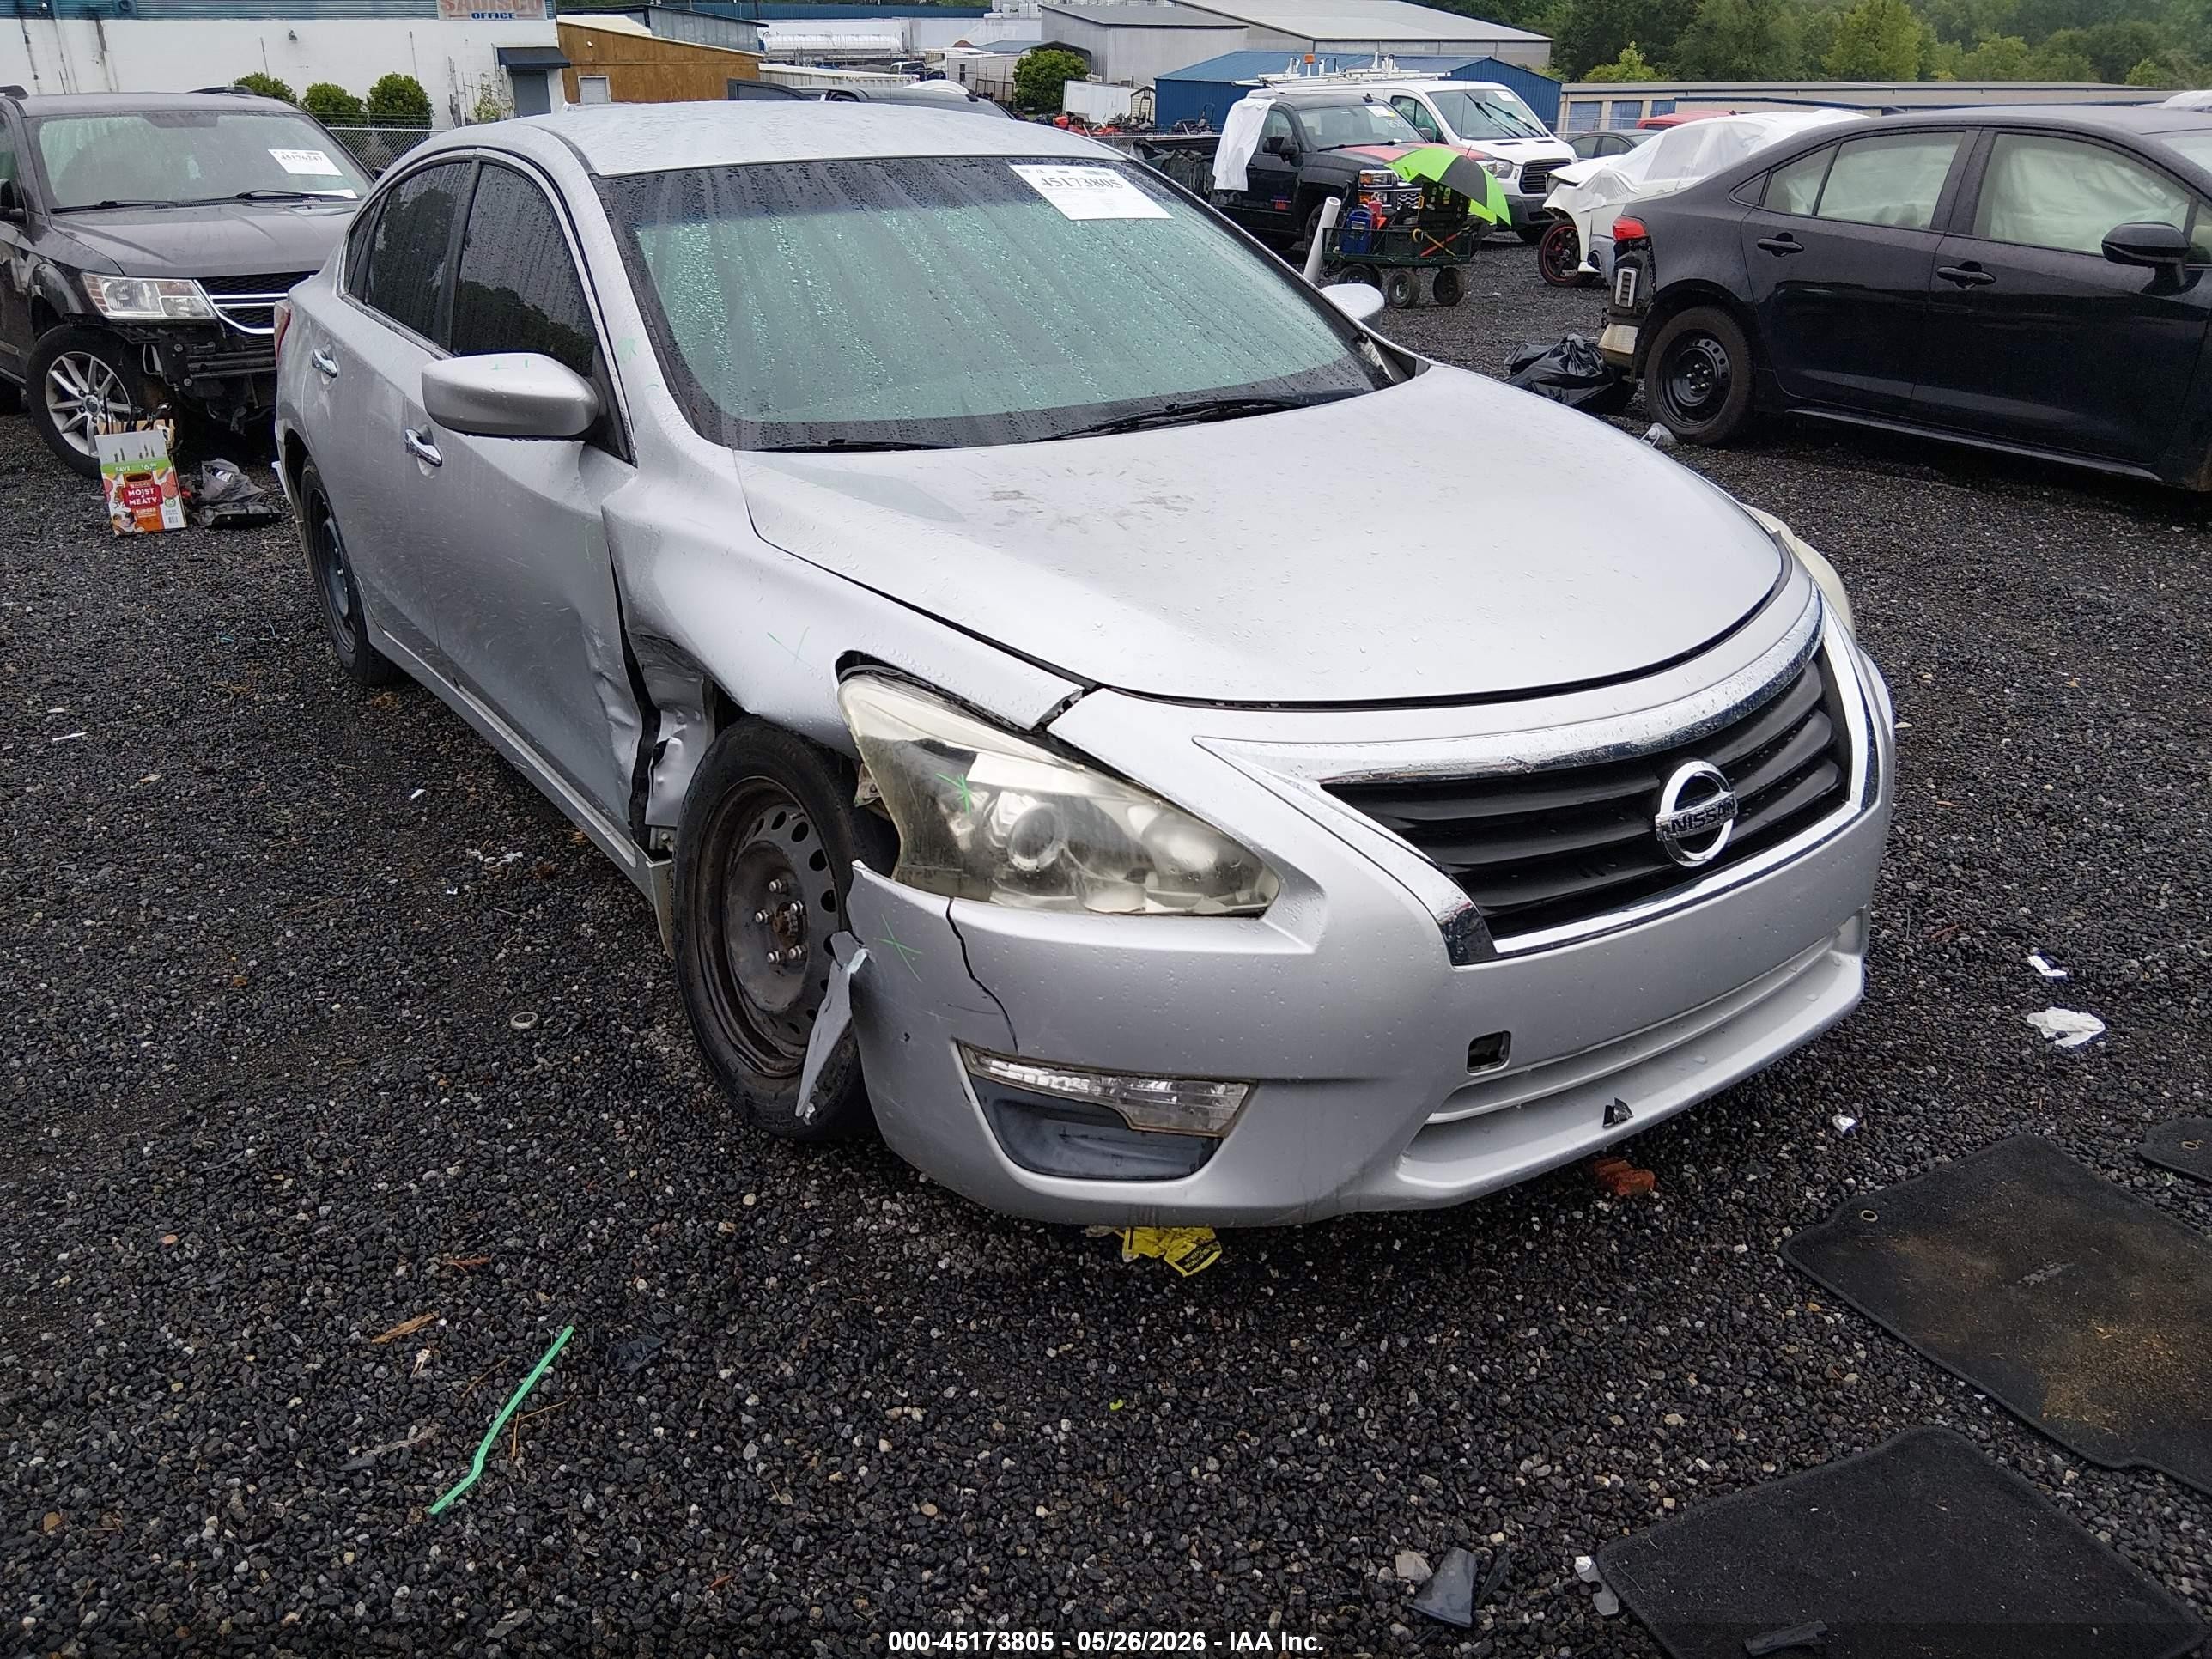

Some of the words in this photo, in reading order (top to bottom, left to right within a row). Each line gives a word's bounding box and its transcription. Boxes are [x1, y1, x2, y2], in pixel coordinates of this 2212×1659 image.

[1040, 177, 1124, 189] 45173805
[128, 487, 155, 496] MOIST
[129, 496, 157, 507] MEATY
[1669, 799, 1734, 831] NISSAN
